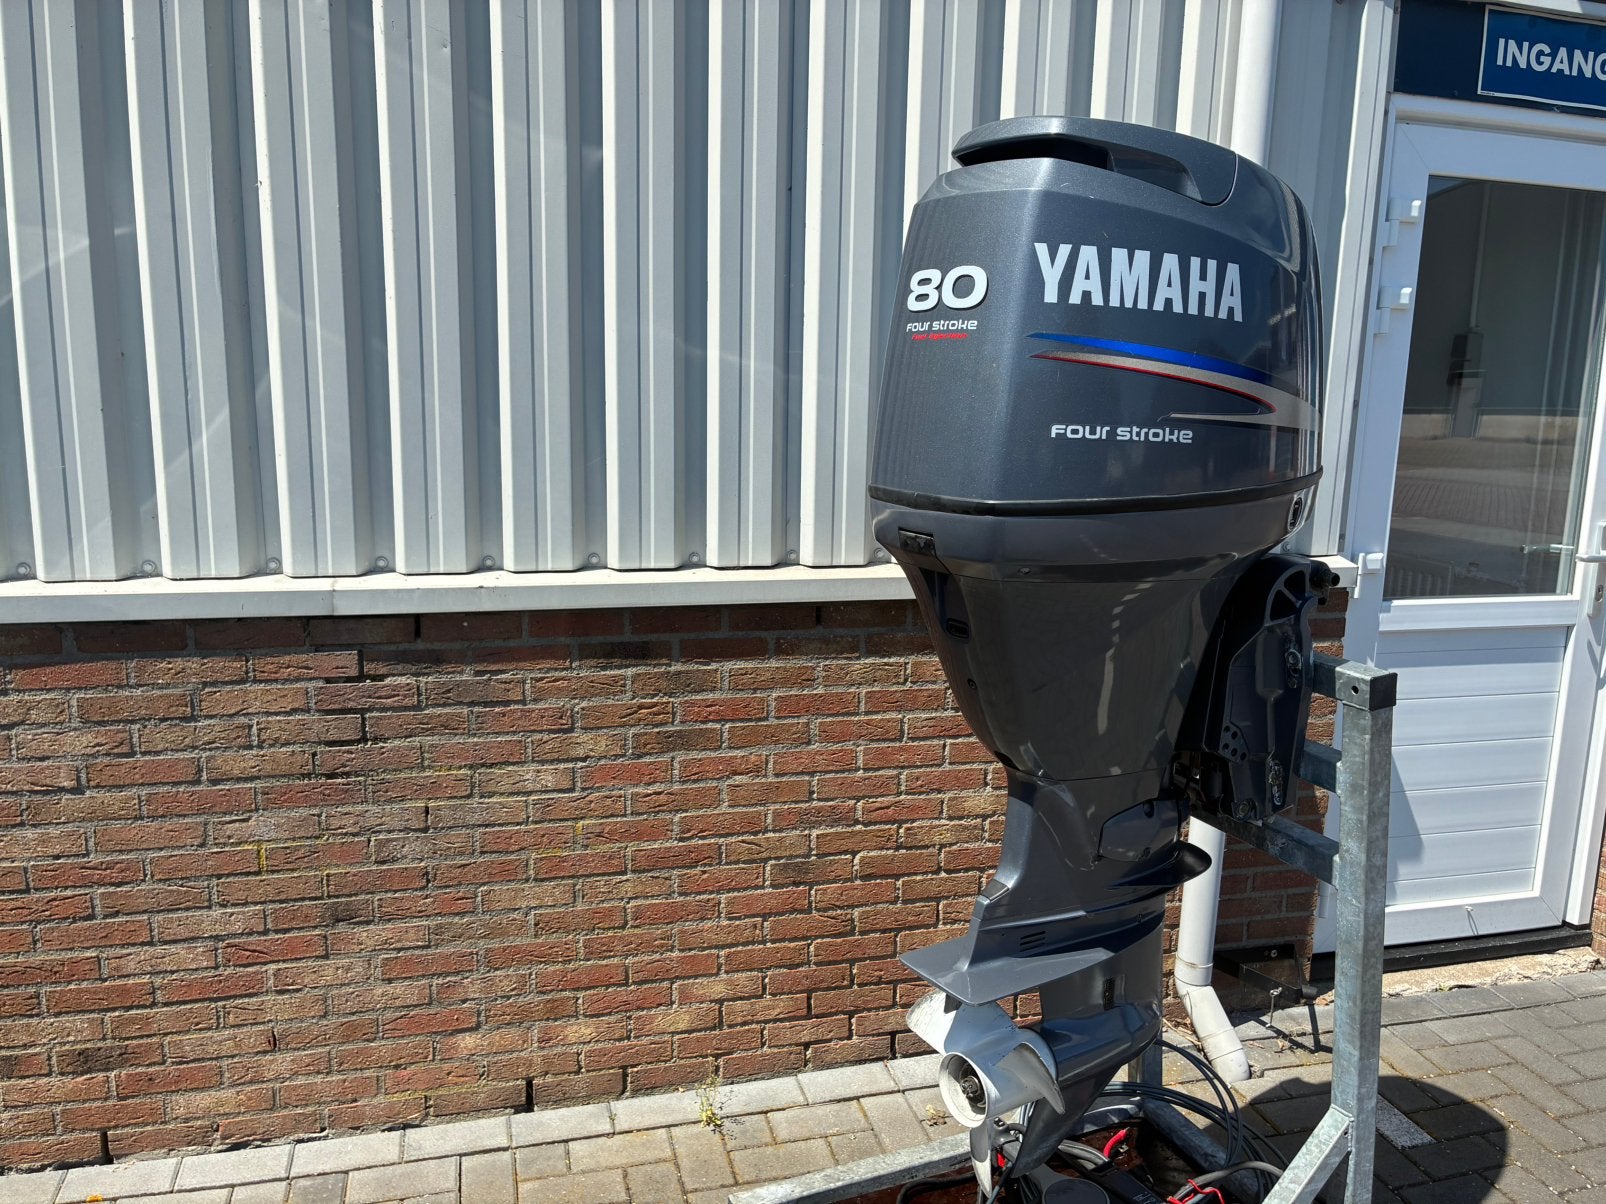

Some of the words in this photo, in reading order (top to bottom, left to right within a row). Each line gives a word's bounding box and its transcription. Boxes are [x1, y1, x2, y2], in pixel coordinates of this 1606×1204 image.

[907, 265, 988, 312] 80
[1034, 242, 1243, 322] YAMAHA
[1116, 425, 1193, 444] stroke
